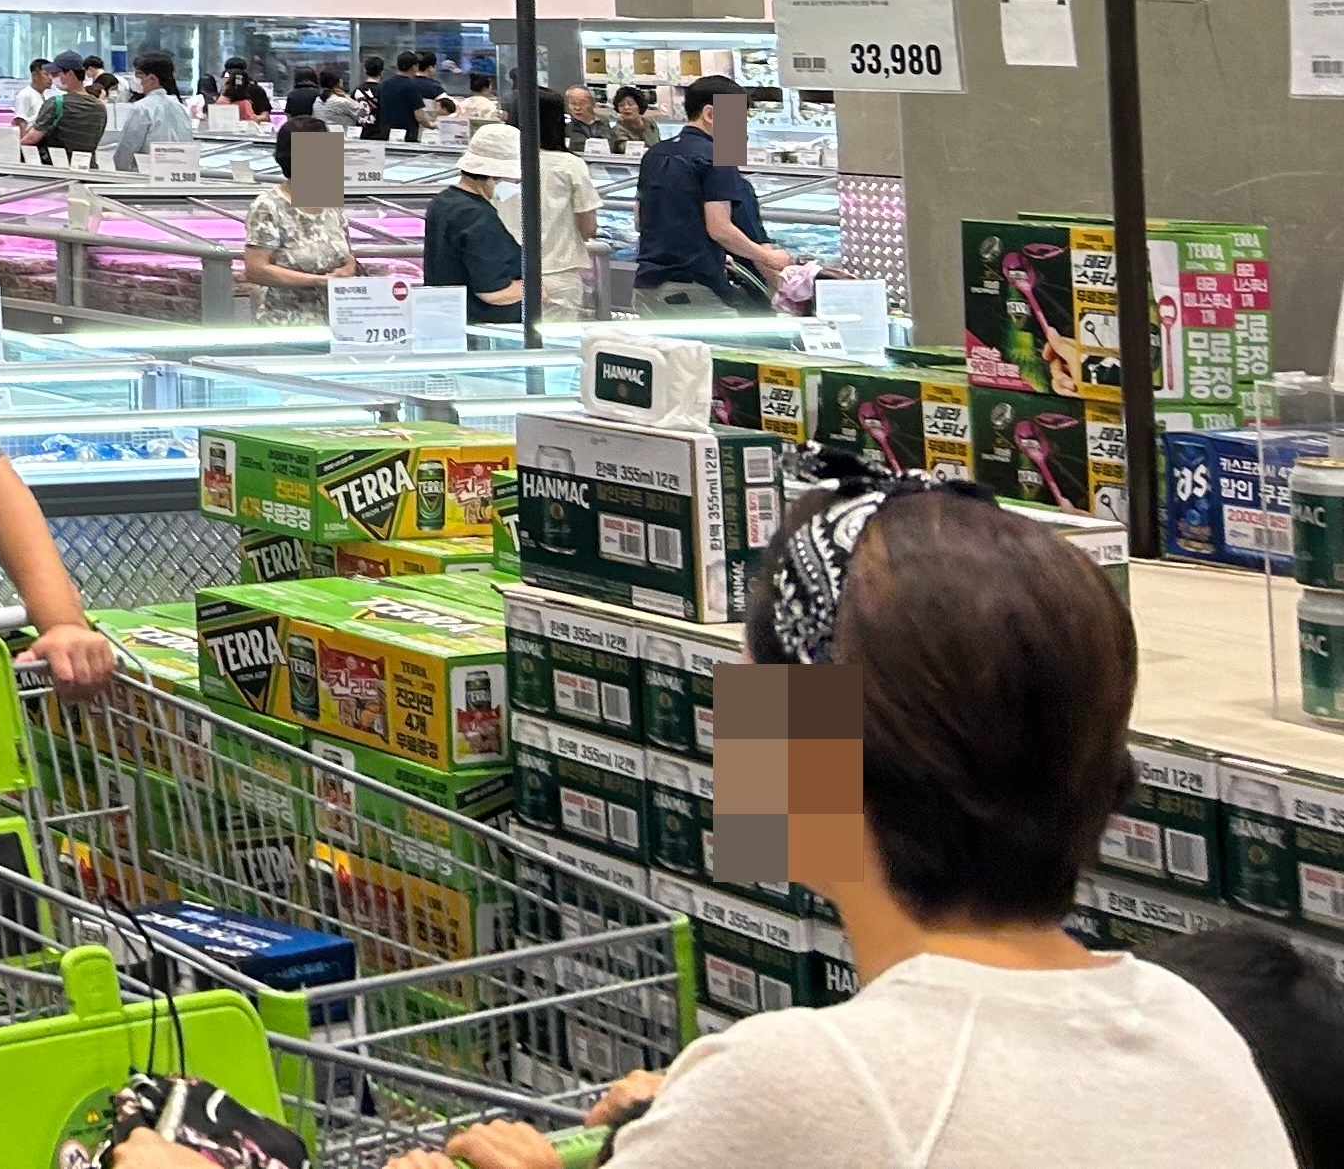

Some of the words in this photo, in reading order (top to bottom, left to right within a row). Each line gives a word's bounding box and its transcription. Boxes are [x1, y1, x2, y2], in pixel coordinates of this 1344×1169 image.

[850, 43, 942, 79] 33,980
[602, 362, 646, 386] HANMAC
[770, 387, 794, 402] 테라
[763, 402, 800, 418] 스푸너
[934, 406, 962, 420] 테라
[926, 420, 968, 438] 스푸너
[704, 447, 718, 476] 12캔
[330, 459, 417, 521] TERRA
[454, 475, 492, 504] 진라
[522, 472, 591, 511] HANMAC
[619, 464, 654, 487] 355ml
[655, 470, 681, 492] 12캔
[1219, 477, 1253, 502] 할인
[706, 479, 722, 522] 355ml
[248, 539, 311, 582] TERRA
[731, 560, 747, 612] HANMAC
[572, 624, 603, 646] 355ml
[207, 625, 287, 677] TERRA
[580, 742, 612, 767] 355ml
[1140, 762, 1169, 784] 5ml
[1171, 768, 1204, 793] 12캔
[727, 910, 762, 937] 355ml
